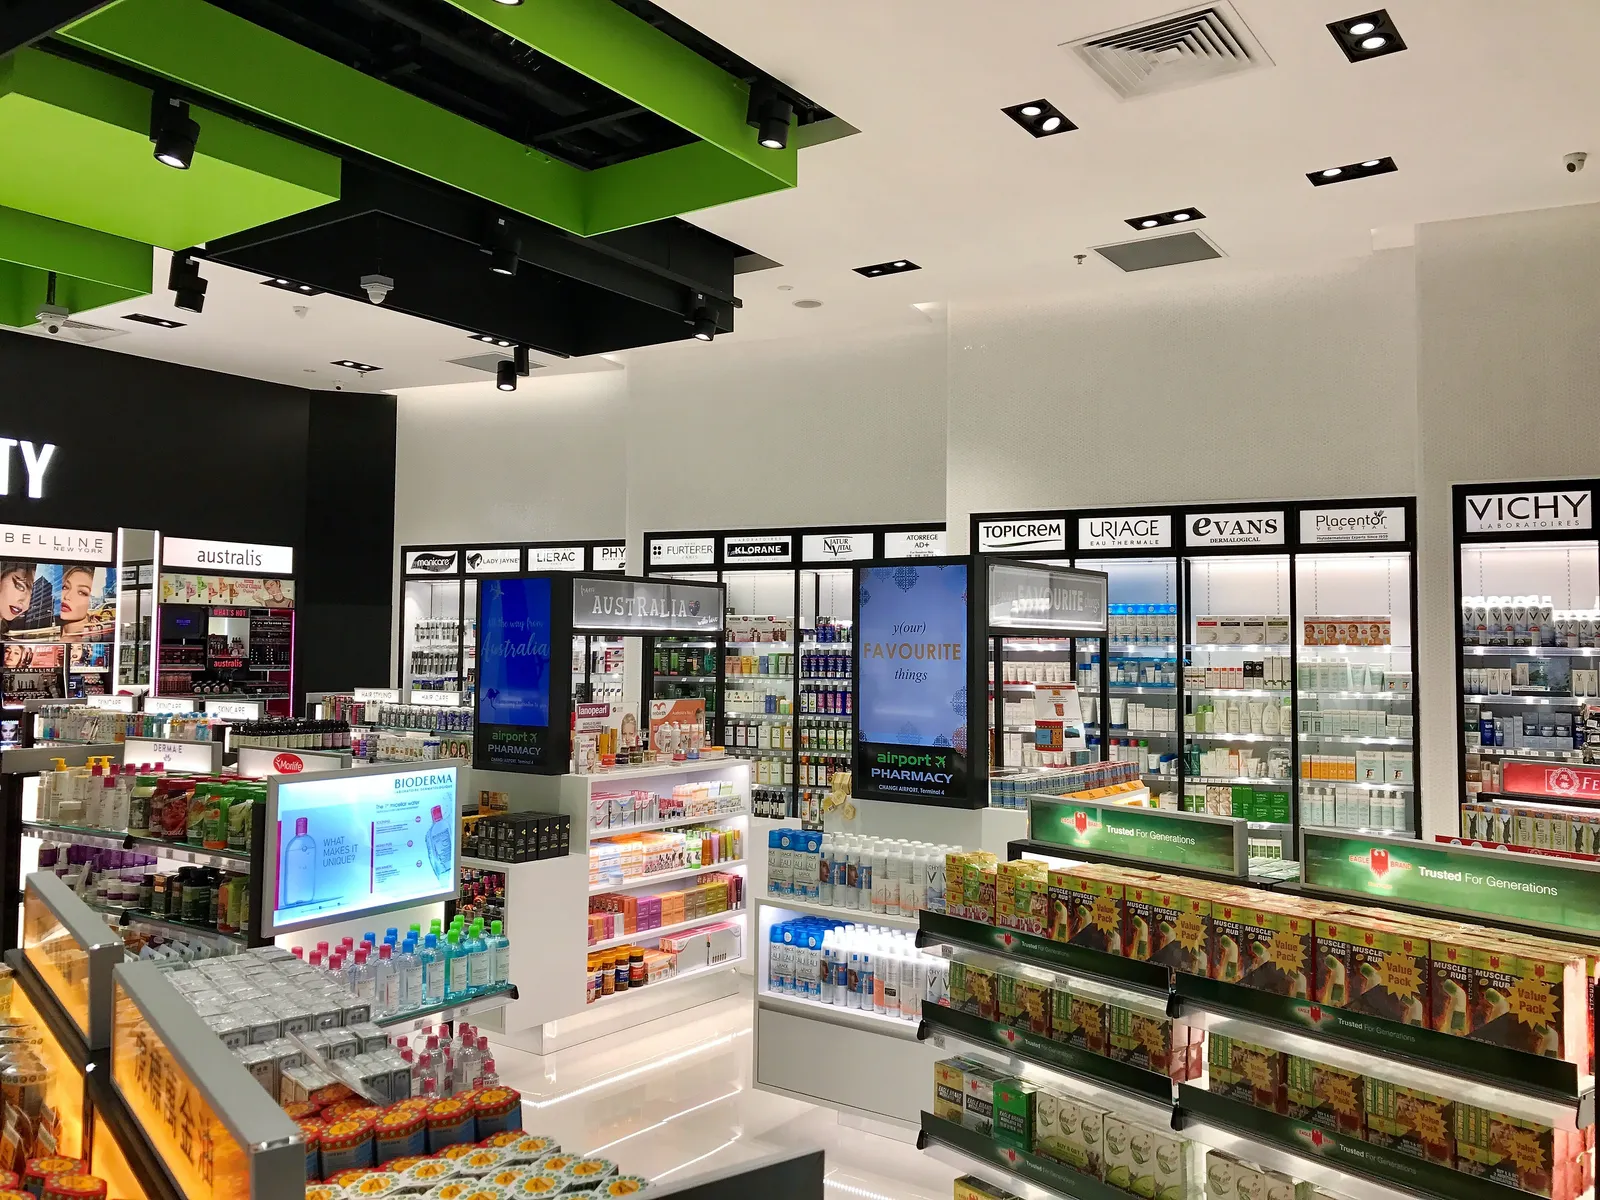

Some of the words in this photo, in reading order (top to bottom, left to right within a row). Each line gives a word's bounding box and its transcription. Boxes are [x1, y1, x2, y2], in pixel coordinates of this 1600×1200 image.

[1468, 493, 1589, 520] VICHY
[1090, 519, 1159, 540] URIAGE
[1480, 520, 1580, 529] LABORATOIRES
[666, 544, 713, 555] FURTERER
[734, 545, 782, 555] KLORANE
[197, 549, 262, 566] australis
[416, 558, 450, 567] manicare
[536, 551, 576, 562] LIERAC
[592, 595, 688, 618] AUSTRALIA
[236, 609, 247, 617] HOT
[892, 620, 927, 636] y(our)
[480, 632, 550, 663] Australia
[863, 642, 961, 660] FAVOURITE
[894, 668, 928, 684] things
[218, 705, 246, 715] SKINCARE
[492, 731, 528, 743] airport
[488, 744, 542, 756] PHARMACY
[877, 751, 932, 767] airport
[280, 761, 303, 772] Morlife
[394, 774, 453, 789] BIODERMA
[871, 768, 954, 784] PHARMACY
[1106, 824, 1135, 837] Trusted
[1135, 828, 1149, 839] For
[1149, 830, 1196, 846] Generations
[323, 836, 345, 847] WHAT
[323, 845, 350, 857] MAKES
[351, 844, 358, 853] IT
[323, 854, 356, 868] UNIQUE?
[1348, 854, 1370, 864] EAGLE
[1390, 860, 1412, 870] BRAND
[1418, 866, 1462, 882] Trusted
[1465, 872, 1483, 886] For
[1486, 876, 1558, 896] Generations
[1096, 903, 1114, 914] Value
[1127, 901, 1149, 911] MUSCLE
[1153, 907, 1177, 916] MUSCLE
[1097, 913, 1113, 923] Pack
[1180, 920, 1200, 932] Value
[1213, 920, 1239, 930] MUSCLE
[1245, 926, 1272, 936] MUSCLE
[1181, 930, 1199, 941] Pack
[1225, 928, 1239, 936] RUB
[1022, 940, 1038, 950] Trusted
[1275, 939, 1298, 952] Value
[1317, 938, 1346, 949] MUSCLE
[1276, 951, 1297, 963] Pack
[1331, 947, 1346, 956] RUB
[1352, 946, 1383, 957] MUSCLE
[1386, 961, 1413, 976] Value
[1433, 961, 1467, 973] MUSCLE
[1388, 974, 1412, 988] Pack
[1450, 971, 1467, 981] RUB
[1475, 969, 1511, 982] MUSCLE
[1517, 987, 1548, 1003] Value
[1519, 1001, 1546, 1015] Pack
[1338, 1017, 1363, 1029] Trusted
[1364, 1024, 1375, 1033] For
[1376, 1027, 1416, 1042] Generations
[1340, 1143, 1365, 1158] Trusted
[1377, 1154, 1417, 1175] Generations
